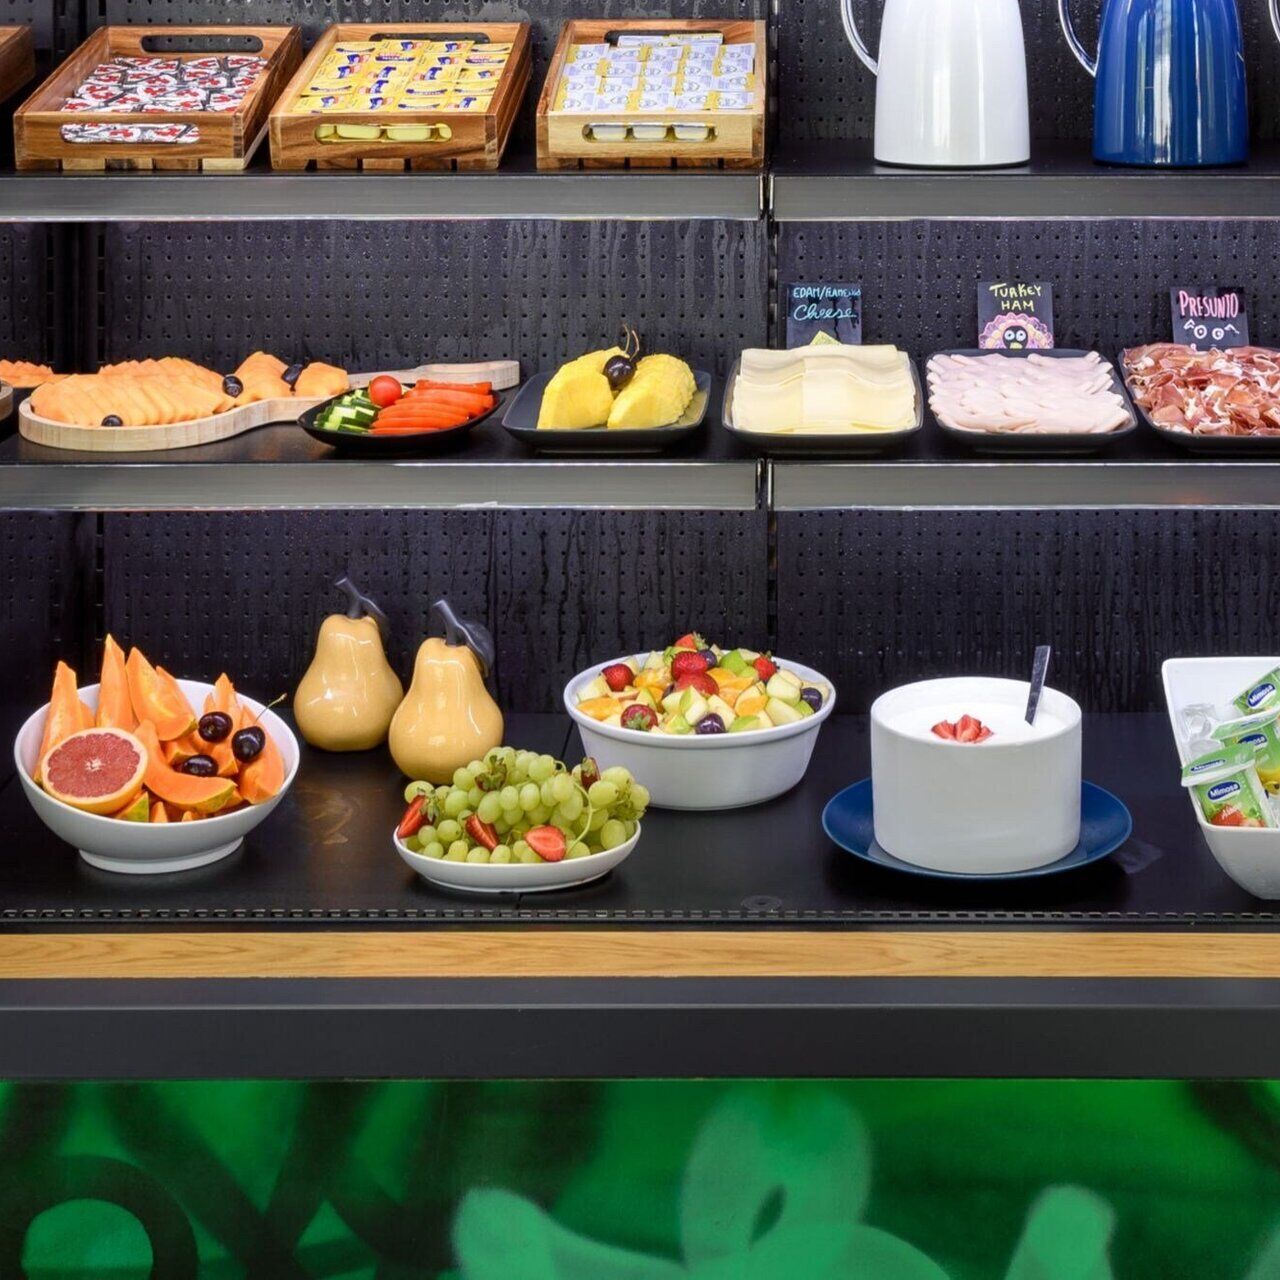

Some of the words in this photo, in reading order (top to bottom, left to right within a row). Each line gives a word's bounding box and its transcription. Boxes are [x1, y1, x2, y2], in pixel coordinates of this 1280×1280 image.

[989, 283, 1042, 298] TURKEY
[793, 303, 858, 321] Cheese
[1001, 299, 1035, 312] HAM
[1179, 290, 1239, 318] PRESUNTO
[1249, 684, 1274, 705] Mimosa
[1209, 783, 1240, 799] Mimosa
